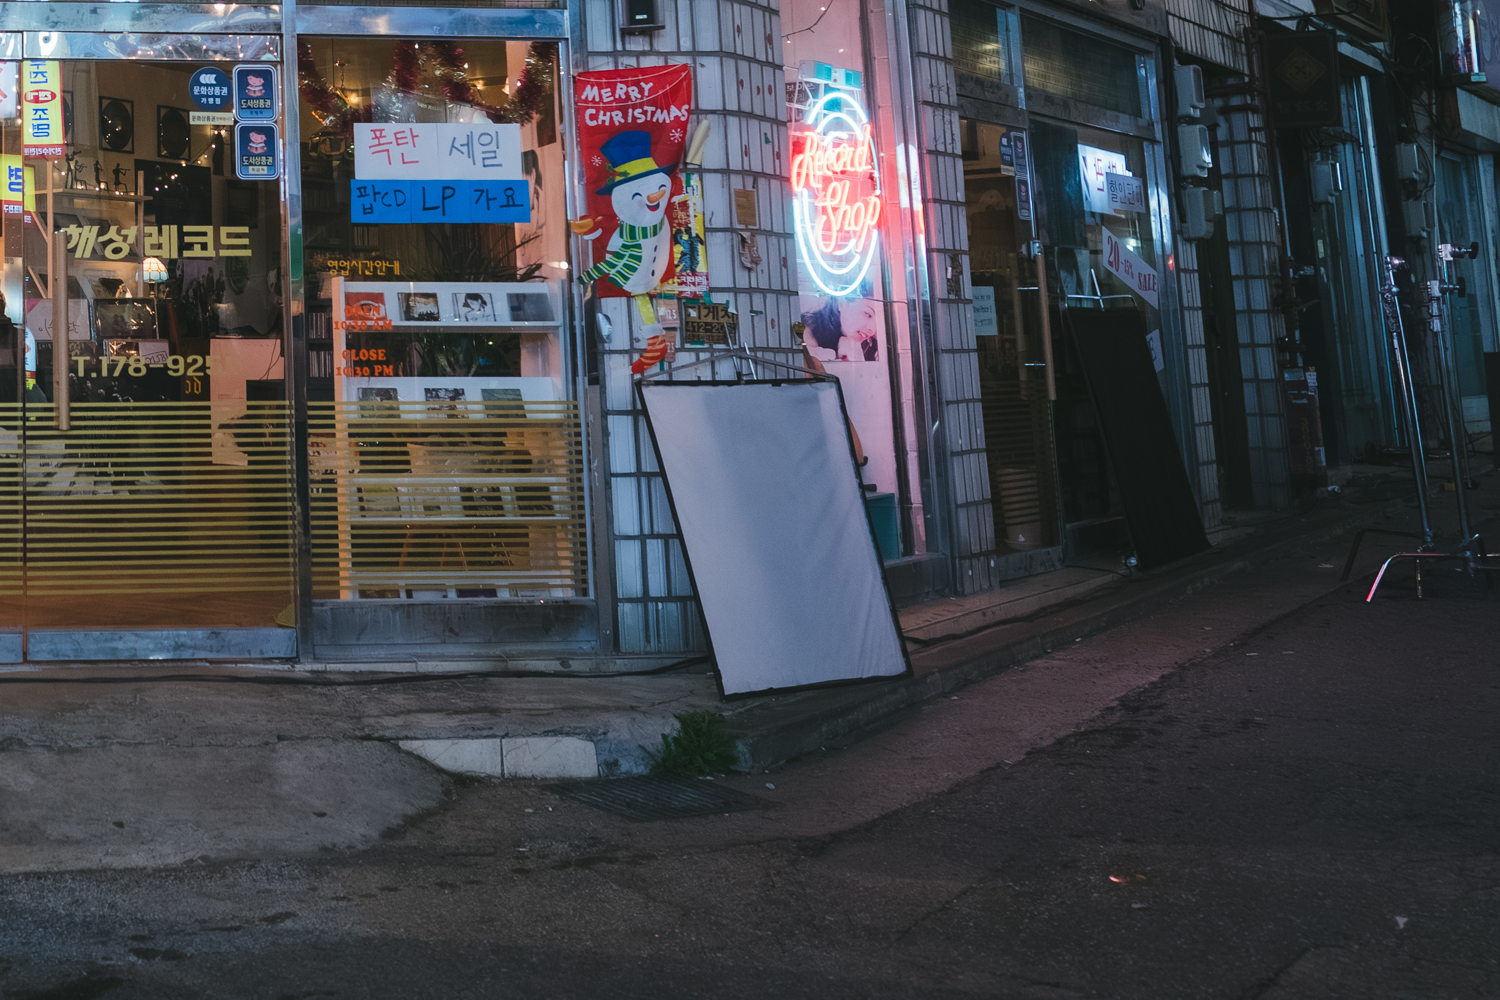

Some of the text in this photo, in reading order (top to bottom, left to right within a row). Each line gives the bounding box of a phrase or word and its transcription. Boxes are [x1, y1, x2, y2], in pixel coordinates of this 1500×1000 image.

[192, 86, 228, 96] 문화상품권
[580, 81, 654, 103] MERRY
[241, 99, 271, 108] 도서상품권
[584, 103, 689, 127] CHRISTMAS
[368, 127, 503, 168] 폭탄 세일
[242, 156, 273, 166] 도서상품권
[791, 122, 881, 253] Record Shop
[421, 185, 456, 216] LP
[473, 186, 524, 211] 가요
[1107, 235, 1120, 273] 20
[1137, 271, 1157, 293] SALE
[343, 305, 381, 317] OPEN
[370, 319, 393, 331] AM
[341, 349, 387, 361] CLOSE
[373, 365, 394, 377] PM
